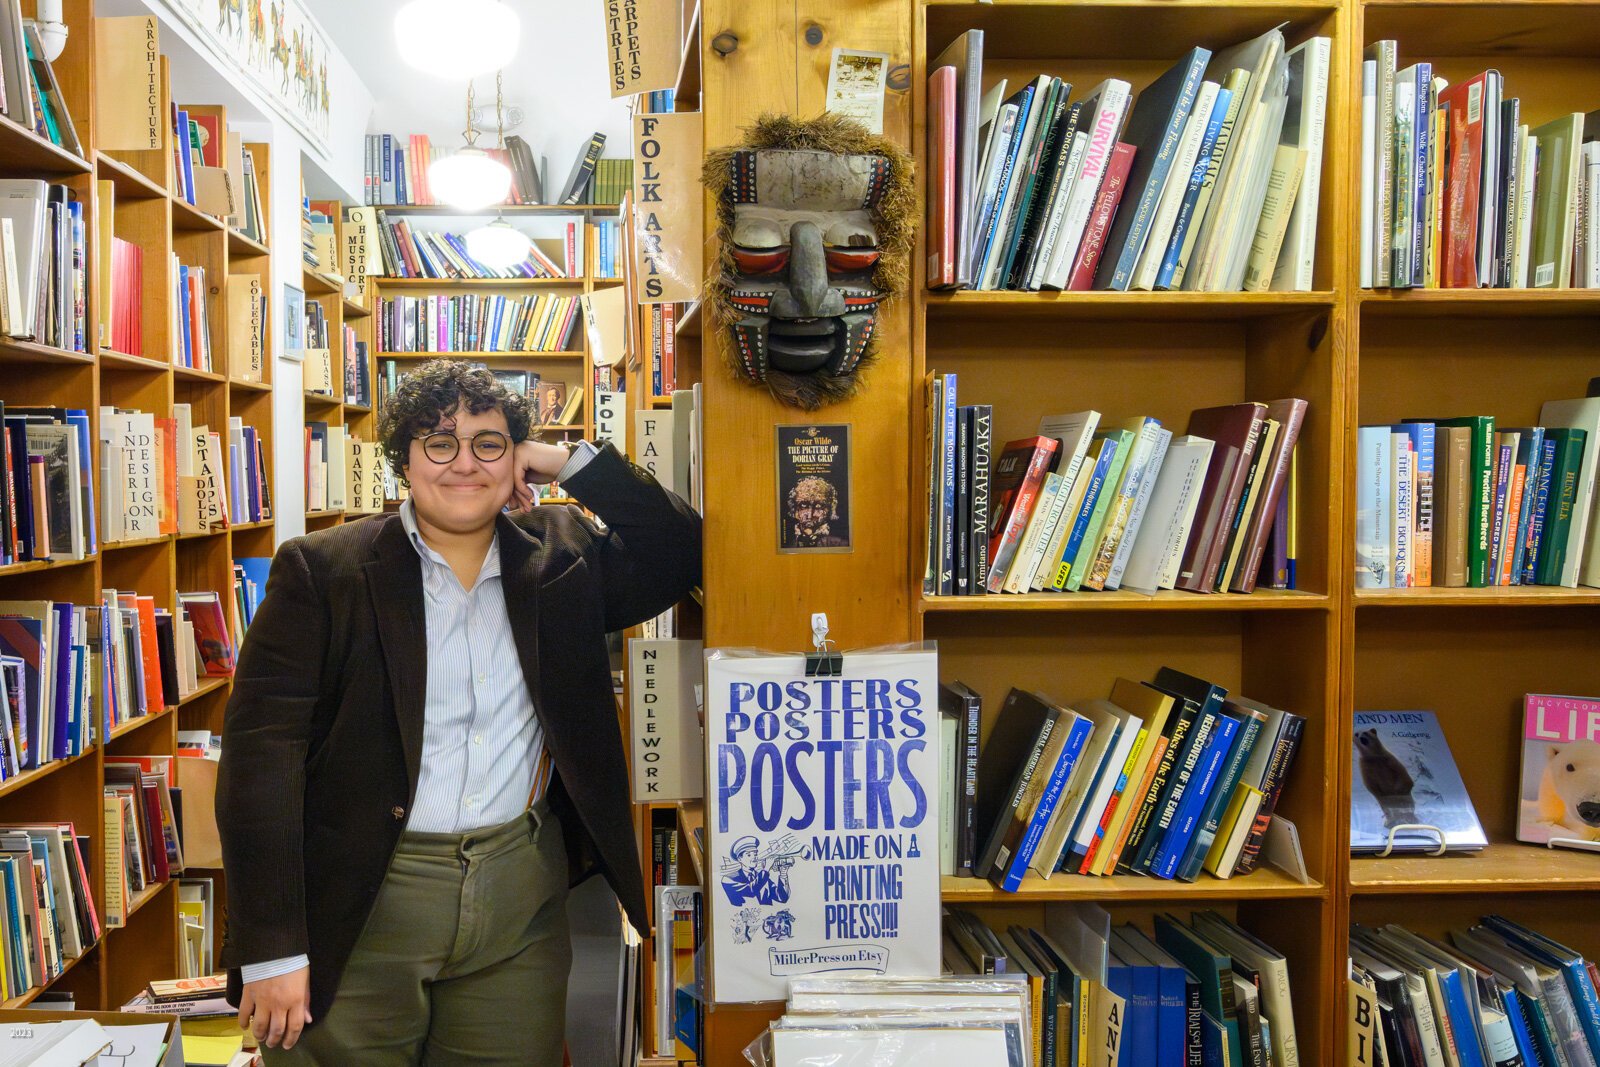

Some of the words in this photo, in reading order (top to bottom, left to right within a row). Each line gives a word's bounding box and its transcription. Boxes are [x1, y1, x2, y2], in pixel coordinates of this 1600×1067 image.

[1385, 46, 1394, 78] AMONG
[146, 18, 157, 149] ARCHITECTURE
[1418, 83, 1427, 113] Kingdom
[1383, 81, 1393, 128] PREDATORS
[1057, 125, 1074, 166] TONGASS
[1079, 108, 1116, 183] SURVIVAL
[1199, 119, 1219, 157] LIVING
[1201, 117, 1233, 189] MAMMALS
[1383, 130, 1391, 148] AND
[640, 118, 662, 202] FOLK
[997, 153, 1012, 192] GALAPAGOS
[1187, 156, 1207, 193] WATER
[1417, 156, 1425, 188] Chadwick
[1382, 179, 1390, 204] HUGO
[1087, 188, 1116, 250] YELLOWSTONE
[1506, 201, 1514, 231] AMERICAN
[1127, 222, 1141, 250] LEYDET
[1505, 232, 1513, 264] MAMMALS
[348, 235, 357, 283] MUSIC
[358, 225, 366, 294] HISTORY
[643, 212, 663, 298] ARTS
[1079, 247, 1096, 269] Story
[250, 279, 259, 372] COLLECTABLES
[322, 351, 330, 388] GLASS
[947, 407, 953, 418] OF
[788, 446, 801, 455] THE
[802, 446, 828, 455] PICTURE
[830, 445, 839, 454] OF
[794, 437, 812, 445] Oscar
[814, 437, 832, 445] Wilde
[1374, 442, 1382, 466] Putting
[1421, 426, 1433, 470] SILENT
[1543, 444, 1554, 461] THE
[792, 454, 816, 463] DORIAN
[817, 454, 833, 463] GRAY
[1067, 453, 1081, 474] THE
[1146, 455, 1157, 474] Nature
[1398, 453, 1406, 477] THE
[124, 421, 141, 531] INTERIOR
[139, 434, 154, 517] DESIGN
[352, 444, 362, 508] DANCE
[372, 447, 383, 508] DANCE
[974, 414, 989, 534] MARAHUAKA
[1056, 475, 1073, 502] HIGH
[1139, 479, 1150, 495] Mark
[1481, 469, 1491, 502] Practical
[1513, 471, 1524, 501] MAMMALS
[1537, 461, 1552, 502] DANCE
[1561, 470, 1576, 499] HUNT
[196, 479, 207, 530] DOLLS
[1014, 491, 1032, 522] Weather
[1080, 476, 1101, 518] EARTHQUAKES
[1118, 470, 1139, 517] COLORADO
[1398, 480, 1406, 521] DESERT
[1496, 493, 1504, 509] THE
[1127, 517, 1136, 531] New
[1532, 516, 1544, 534] LIFE
[1558, 501, 1570, 521] ELK
[1004, 520, 1022, 545] Toys
[1035, 502, 1061, 555] FRONTIER
[1106, 515, 1123, 549] PLATEAU
[1122, 529, 1132, 545] World
[1492, 511, 1501, 542] SACRED
[1506, 511, 1519, 547] SOUTH-EAST
[1397, 525, 1406, 573] BIGHORN
[1490, 543, 1498, 560] PAW
[1504, 549, 1513, 563] ASIA
[976, 544, 986, 586] Armitano
[1054, 564, 1068, 586] USED
[730, 679, 922, 712] POSTERS
[642, 649, 661, 793] NEEDLEWORK
[725, 709, 926, 743] POSTERS
[967, 705, 980, 734] THUNDER
[1037, 718, 1054, 747] CENTRAL
[1167, 717, 1190, 750] Riches
[1223, 722, 1233, 737] SEARLE
[1356, 713, 1388, 724] AND
[1390, 713, 1424, 724] MEN
[967, 743, 977, 755] THE
[1182, 712, 1215, 771] REDISCOVERY
[1397, 731, 1431, 740] Gathering
[1023, 746, 1042, 781] AMERICAN
[1053, 751, 1076, 781] Journey
[1156, 760, 1172, 777] the
[1163, 748, 1177, 763] of
[1208, 749, 1221, 771] COLLIDING
[1270, 737, 1290, 770] Volcanoes
[718, 739, 928, 833] POSTERS
[965, 757, 977, 795] HEARTLAND
[1144, 776, 1165, 805] Earth
[1169, 781, 1185, 801] THE
[1177, 769, 1190, 784] OF
[1198, 770, 1212, 795] CONTINENTS
[1220, 763, 1238, 794] CONTINENT
[1263, 776, 1275, 791] the
[1010, 779, 1028, 808] JUNGLES
[1035, 801, 1052, 821] Age
[1157, 799, 1178, 829] EARTH
[654, 834, 662, 862] WITSEC
[812, 835, 870, 861] MADE
[875, 834, 902, 859] ON
[907, 833, 921, 858] A
[824, 864, 903, 902] PRINTING
[46, 905, 54, 936] KITCHEN
[825, 902, 898, 940] PRESS!!!!
[842, 953, 857, 962] on
[859, 950, 883, 965] Etsy
[1575, 969, 1587, 985] The
[1189, 1007, 1202, 1036] TRIALS
[1189, 1044, 1202, 1066] LIFE
[1251, 1032, 1260, 1048] THE
[1252, 1049, 1261, 1065] END
